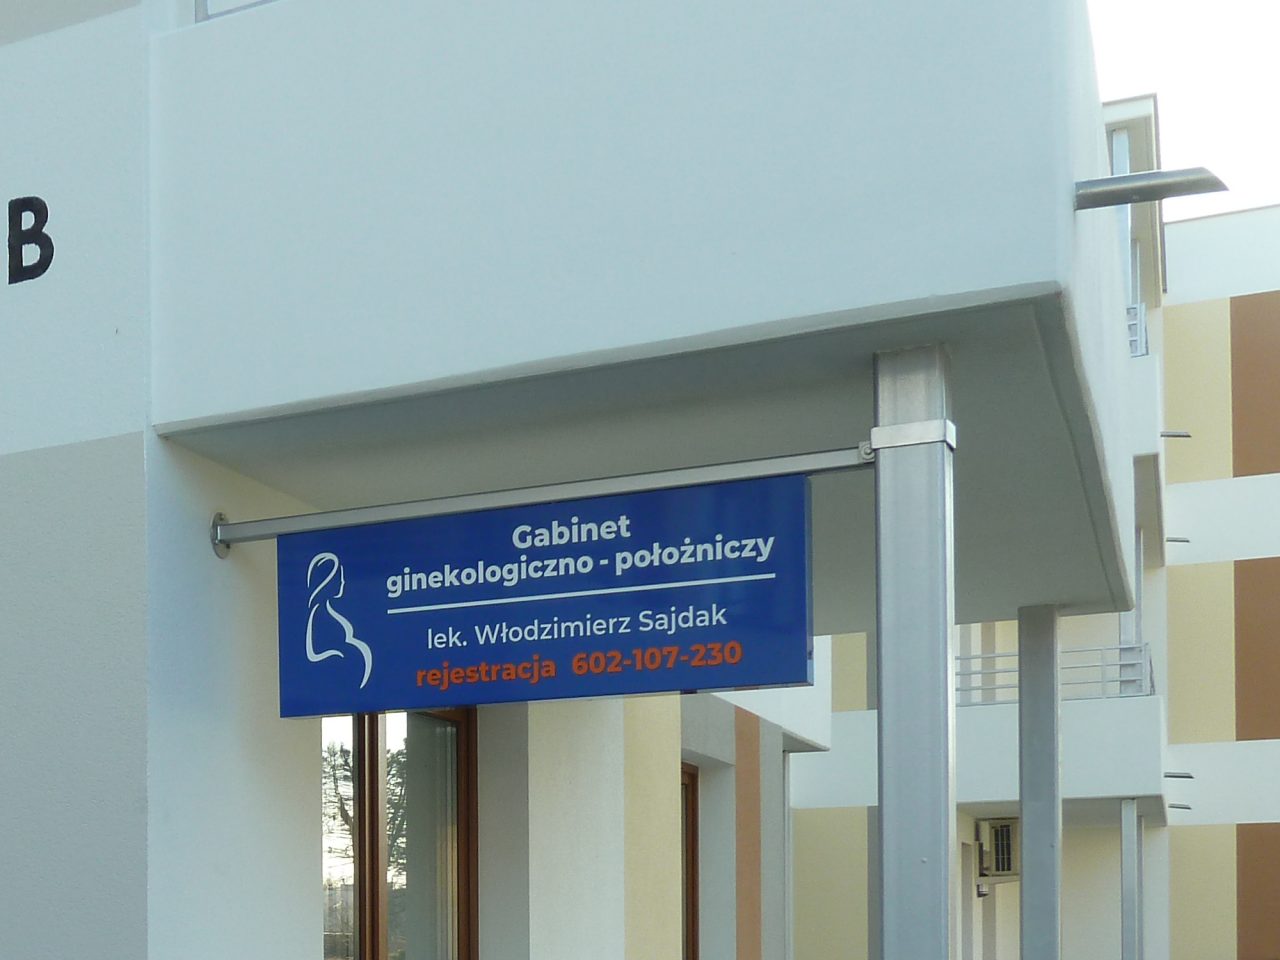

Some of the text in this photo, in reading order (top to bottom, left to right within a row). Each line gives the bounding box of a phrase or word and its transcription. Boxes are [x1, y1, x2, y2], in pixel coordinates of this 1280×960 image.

[511, 515, 631, 550] Gabinet
[386, 554, 595, 599] ginekologiczno
[615, 533, 776, 577] położniczy
[427, 603, 728, 649] lek. Włodzimierz Sajdak
[415, 640, 743, 692] rejestracja 602-107-230
